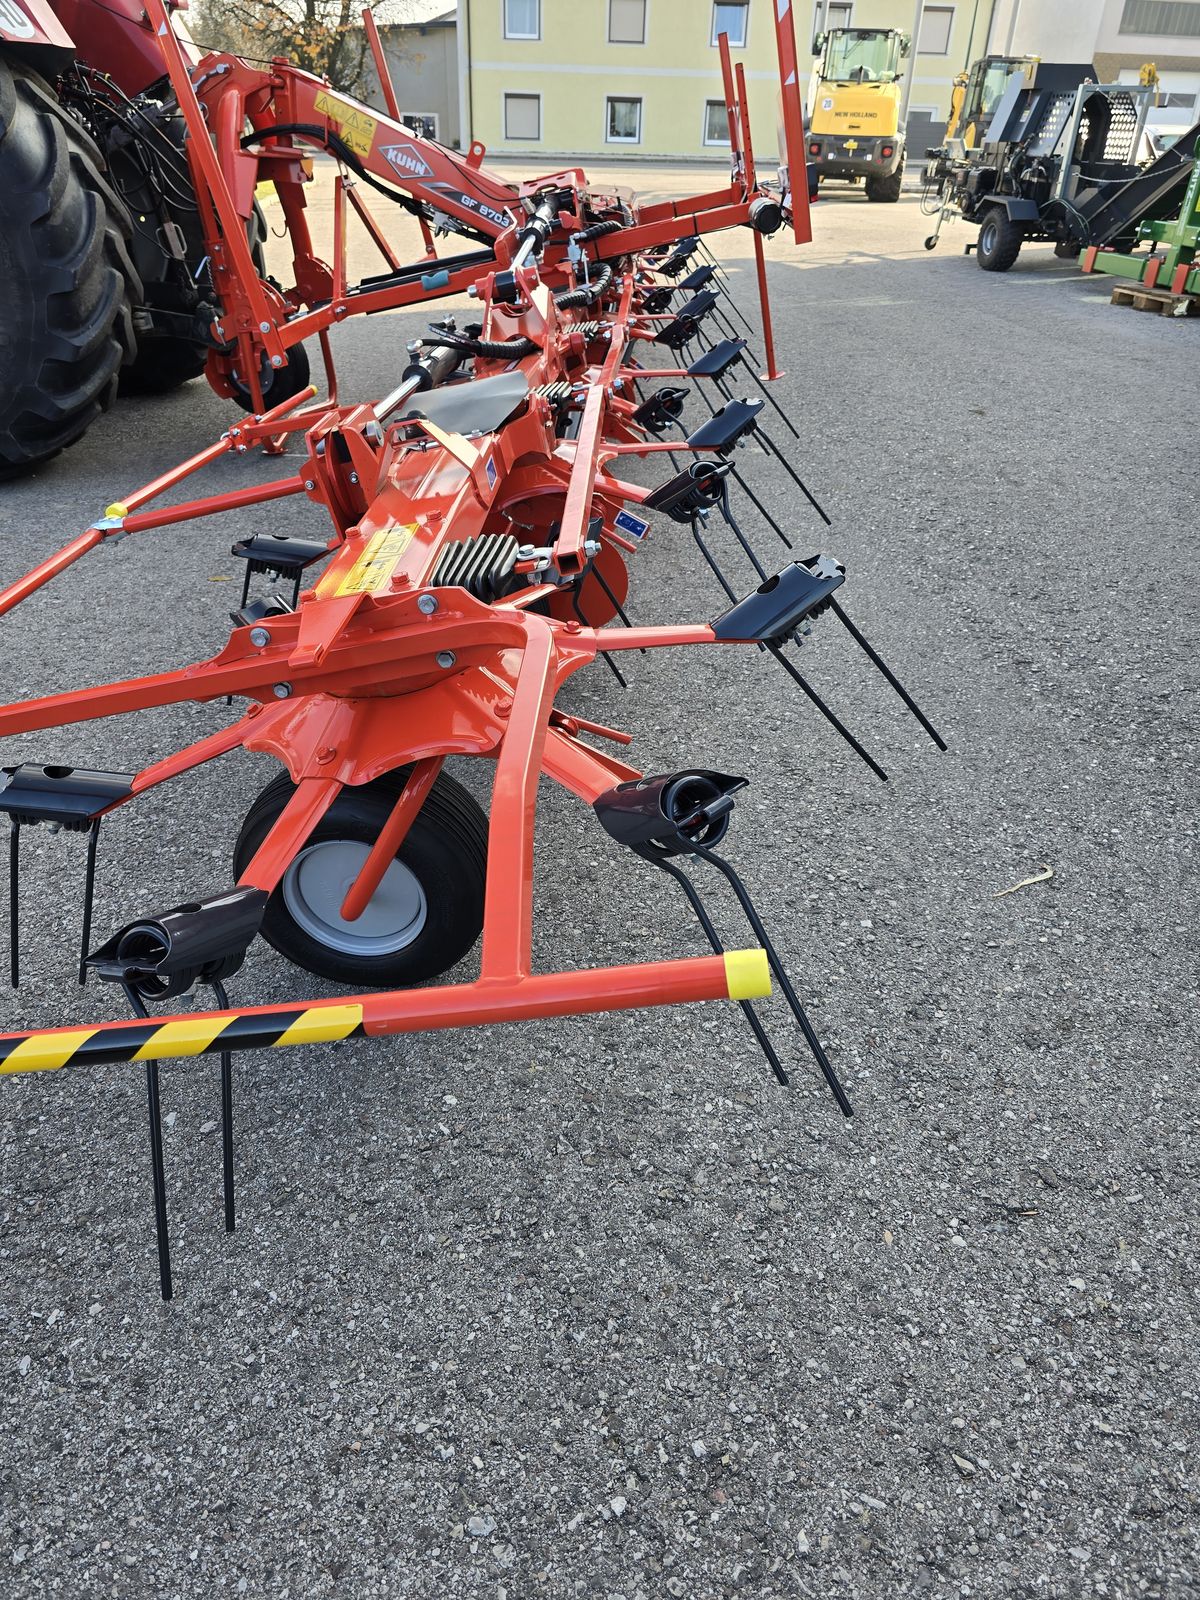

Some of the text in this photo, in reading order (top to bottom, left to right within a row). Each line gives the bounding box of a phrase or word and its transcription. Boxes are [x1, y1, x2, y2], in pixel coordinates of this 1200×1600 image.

[387, 148, 426, 176] KUHN
[460, 194, 510, 228] GF 8703
